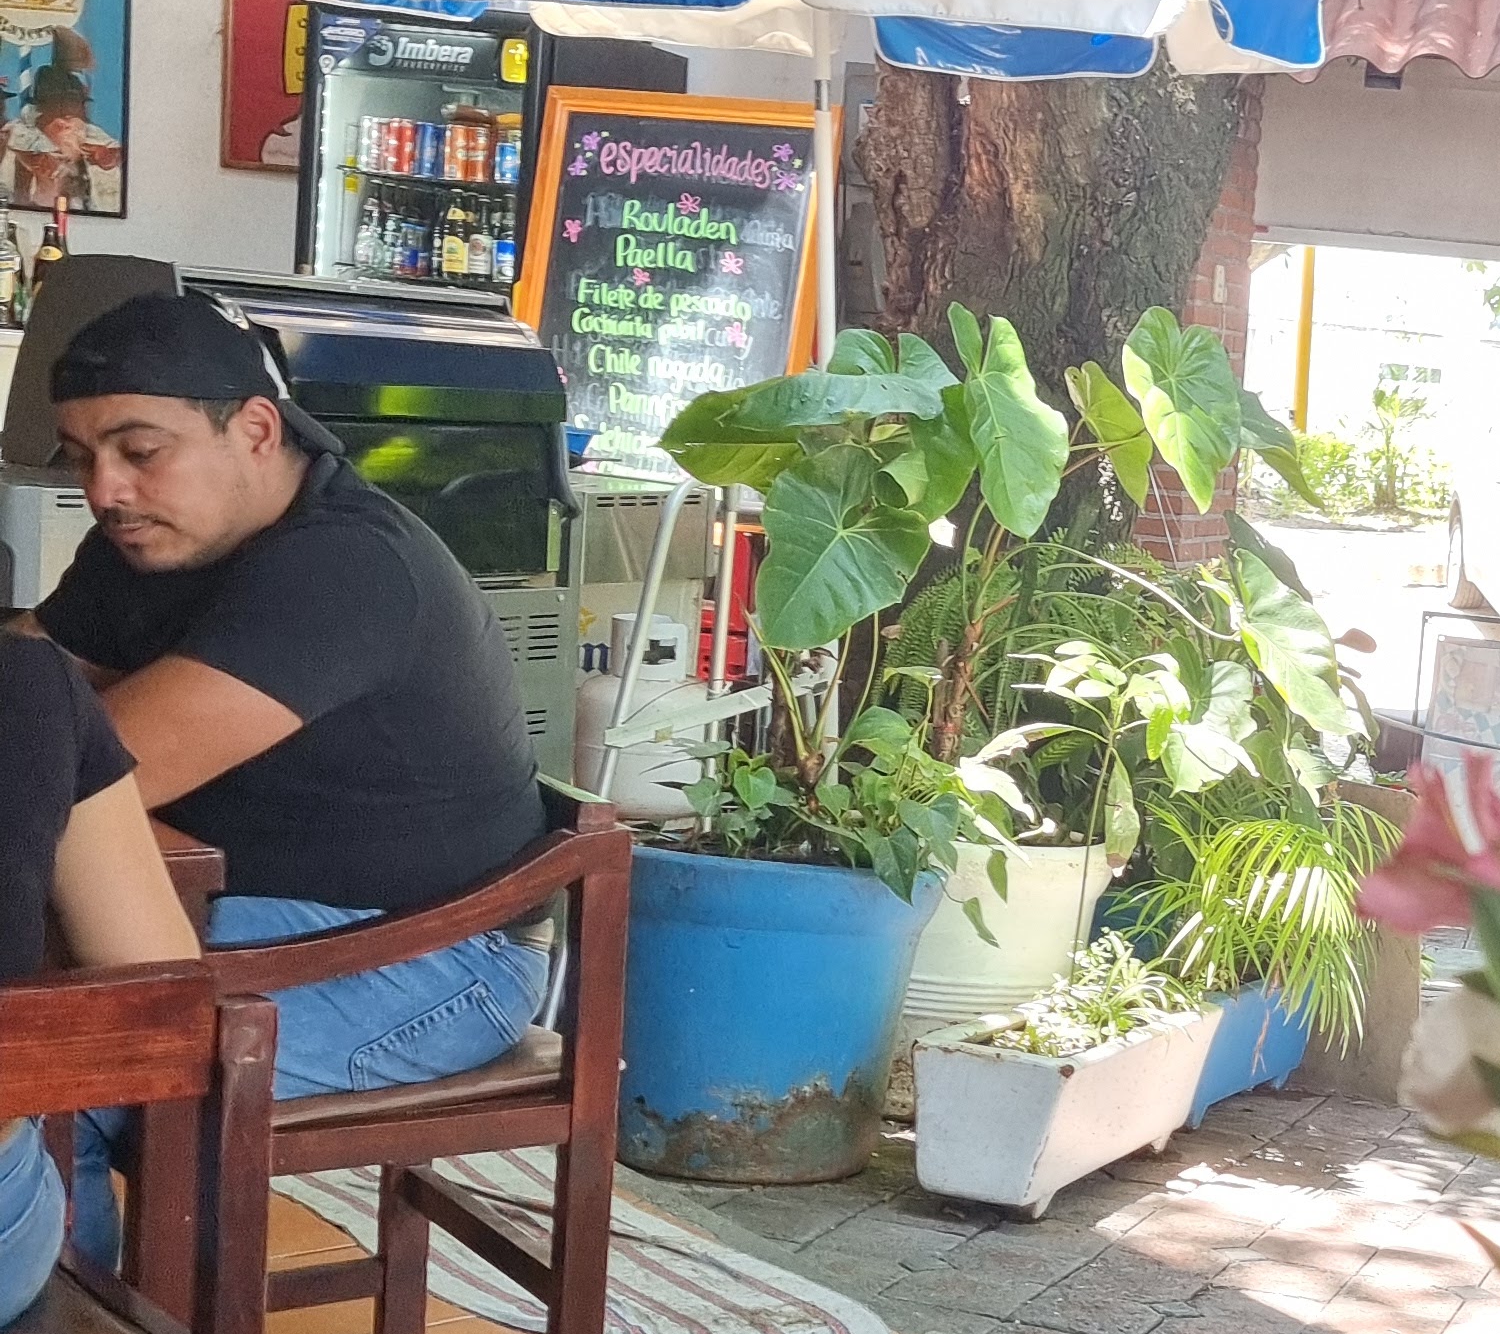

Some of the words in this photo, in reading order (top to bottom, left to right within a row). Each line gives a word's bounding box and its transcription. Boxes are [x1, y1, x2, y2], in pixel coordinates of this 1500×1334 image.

[394, 36, 474, 64] Imbera
[600, 140, 777, 189] especialidades
[622, 199, 738, 245] Rouladen
[615, 233, 697, 273] Paella
[577, 278, 636, 310] Filete
[638, 283, 666, 310] de
[588, 343, 642, 376] Chile
[647, 354, 726, 393] nogada
